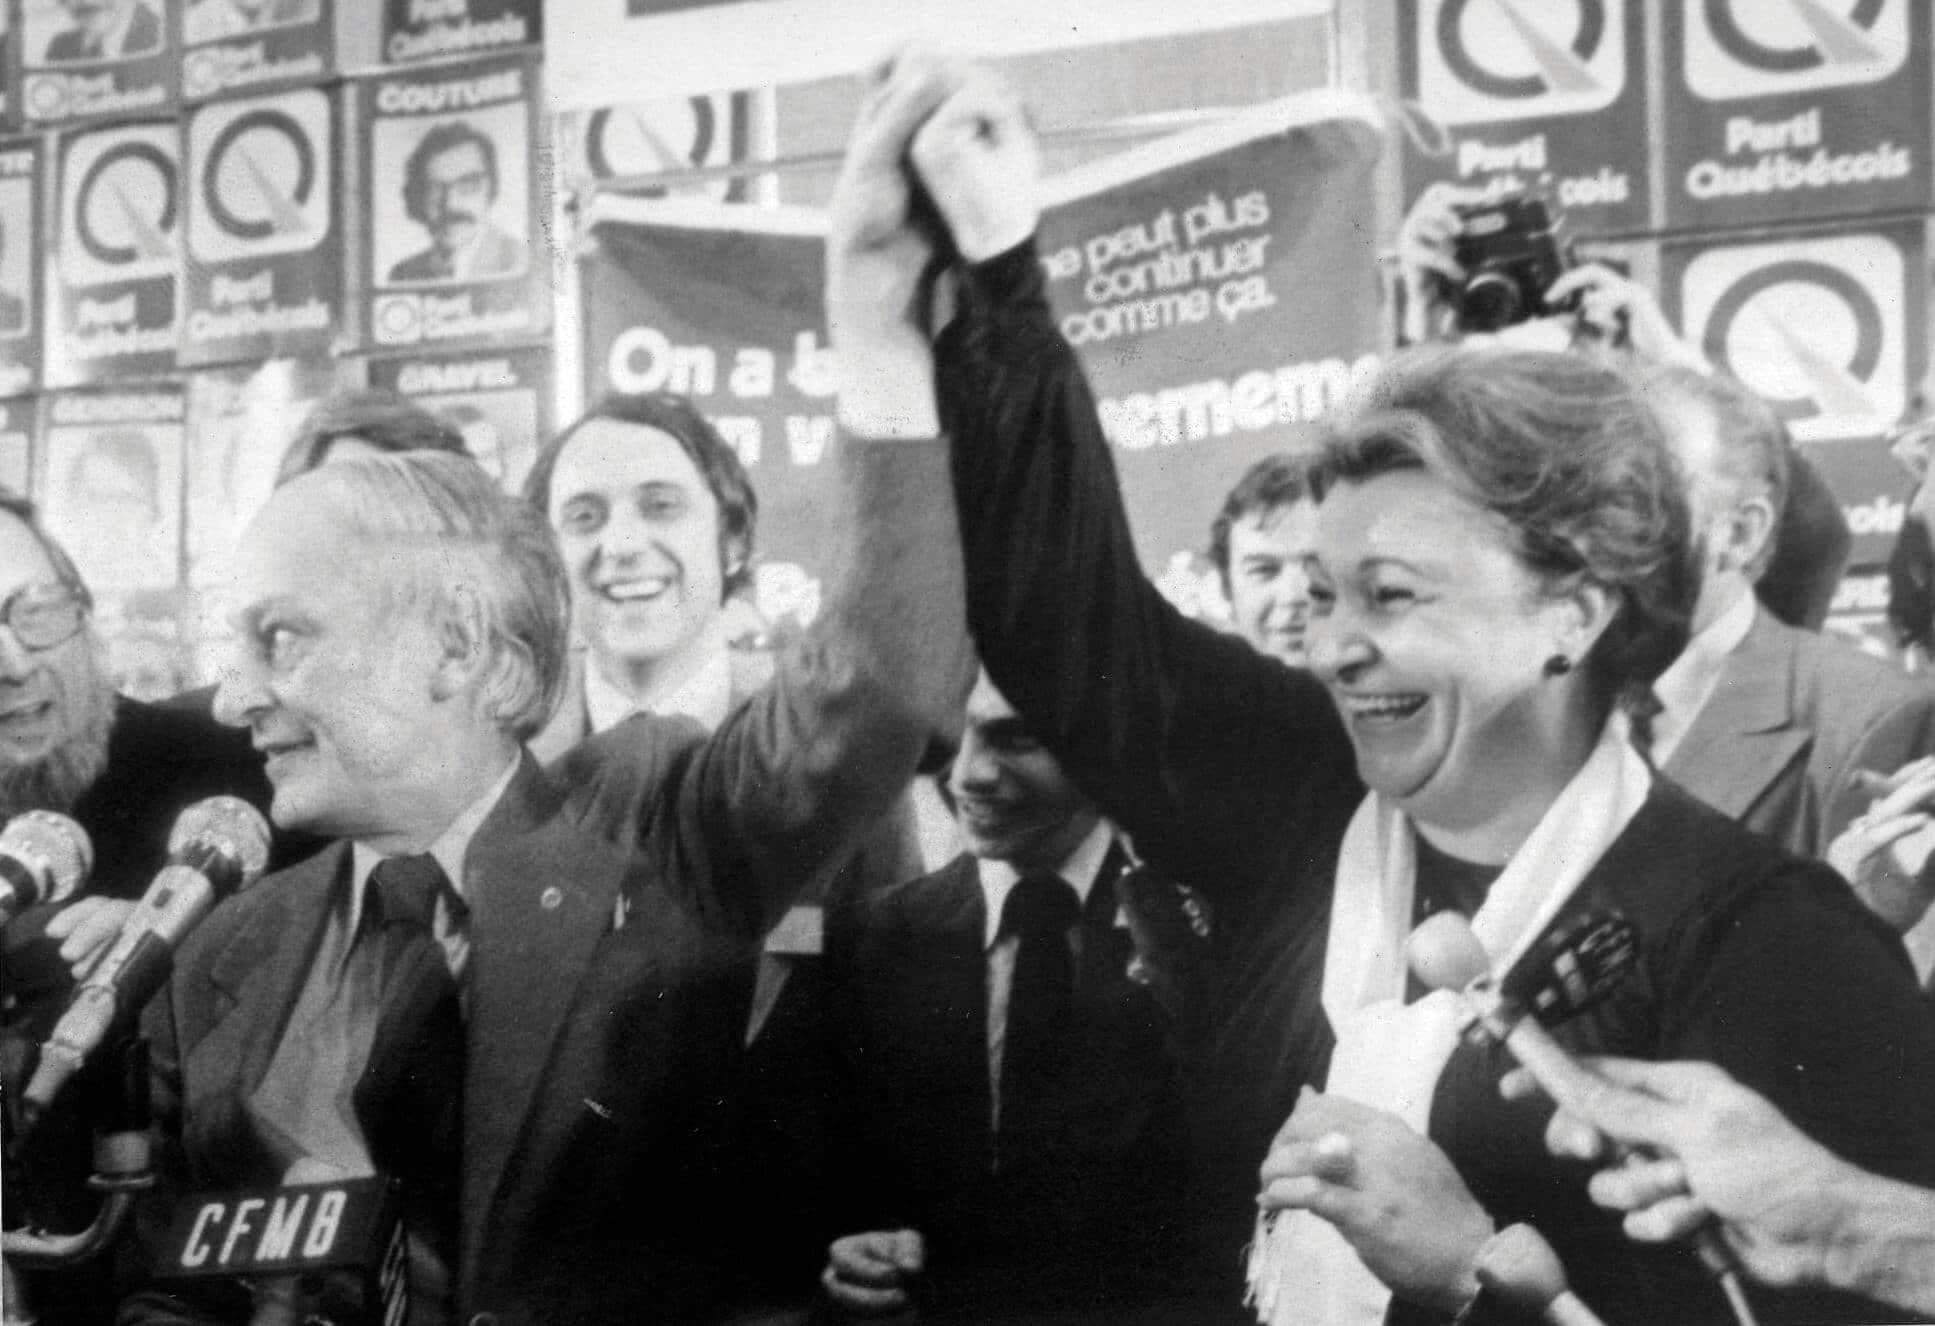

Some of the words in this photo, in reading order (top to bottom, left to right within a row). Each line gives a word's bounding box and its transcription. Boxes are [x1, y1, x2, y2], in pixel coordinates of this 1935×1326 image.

[377, 69, 522, 112] COUTURE
[1458, 133, 1547, 178] Parti
[1726, 106, 1820, 155] Parti
[1685, 141, 1911, 200] Québécois
[1184, 192, 1271, 244] plus
[1085, 234, 1273, 303] continuer
[1060, 288, 1212, 345] comme
[608, 325, 716, 396] On
[728, 346, 775, 397] a
[180, 1190, 348, 1268] CFMB
